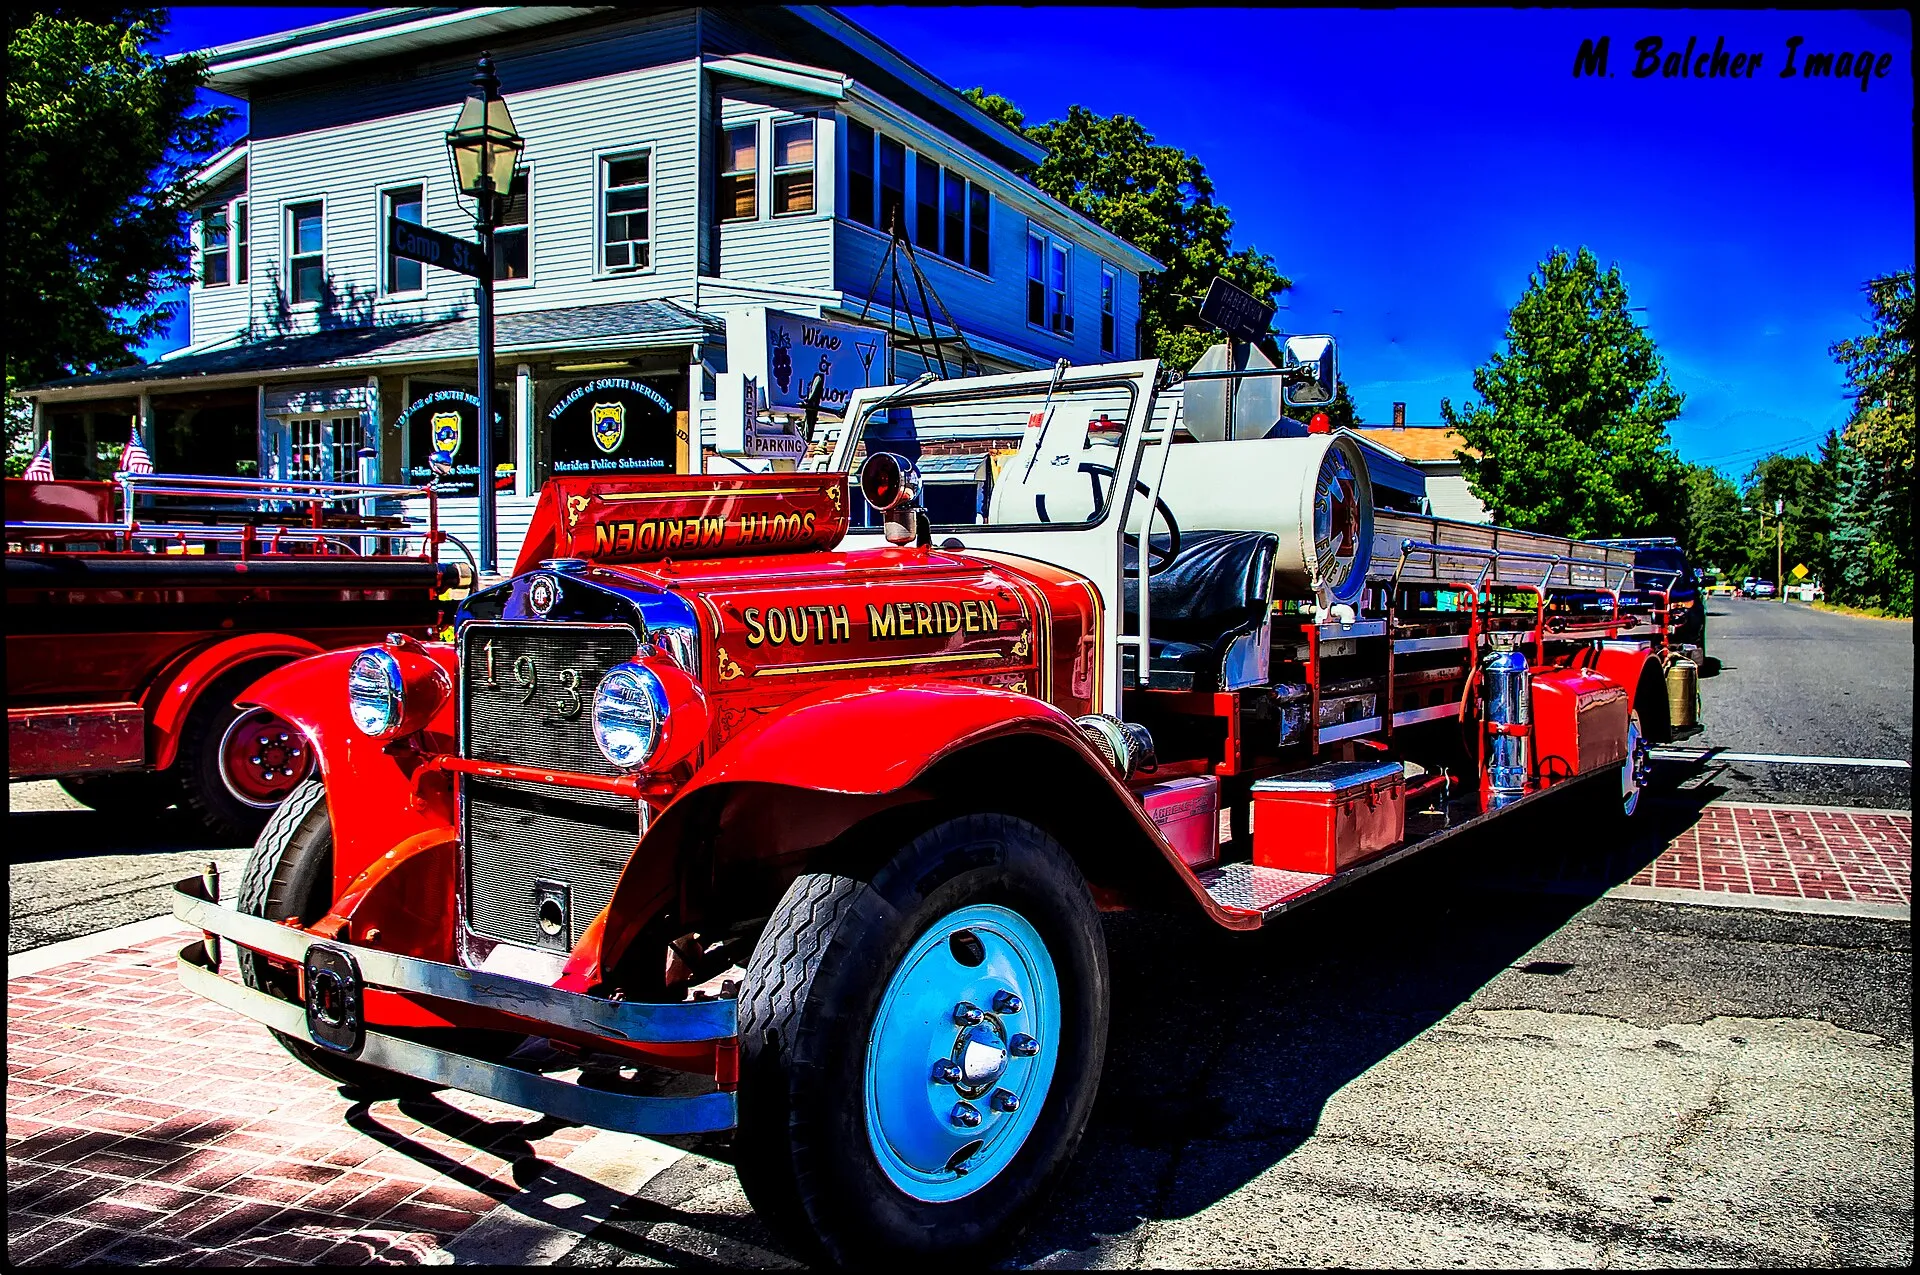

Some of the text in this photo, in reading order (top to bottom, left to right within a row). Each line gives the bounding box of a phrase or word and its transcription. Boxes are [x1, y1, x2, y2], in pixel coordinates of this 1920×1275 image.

[395, 224, 475, 271] Camp St.
[801, 324, 842, 351] Wine
[819, 354, 832, 376] &
[434, 390, 464, 401] SOUTH
[548, 387, 585, 420] VILLAGE
[584, 381, 595, 393] of
[596, 378, 630, 390] SOUTH
[630, 380, 673, 414] MERIDEN
[798, 378, 849, 403] Liuor
[745, 386, 754, 448] REAR
[755, 438, 802, 453] PARKING
[554, 457, 665, 471] Meriden Police Substation
[593, 510, 817, 558] SOUTH MERIDEN
[1315, 537, 1341, 583] FIRE
[744, 600, 999, 645] SOUTH MERIDEN
